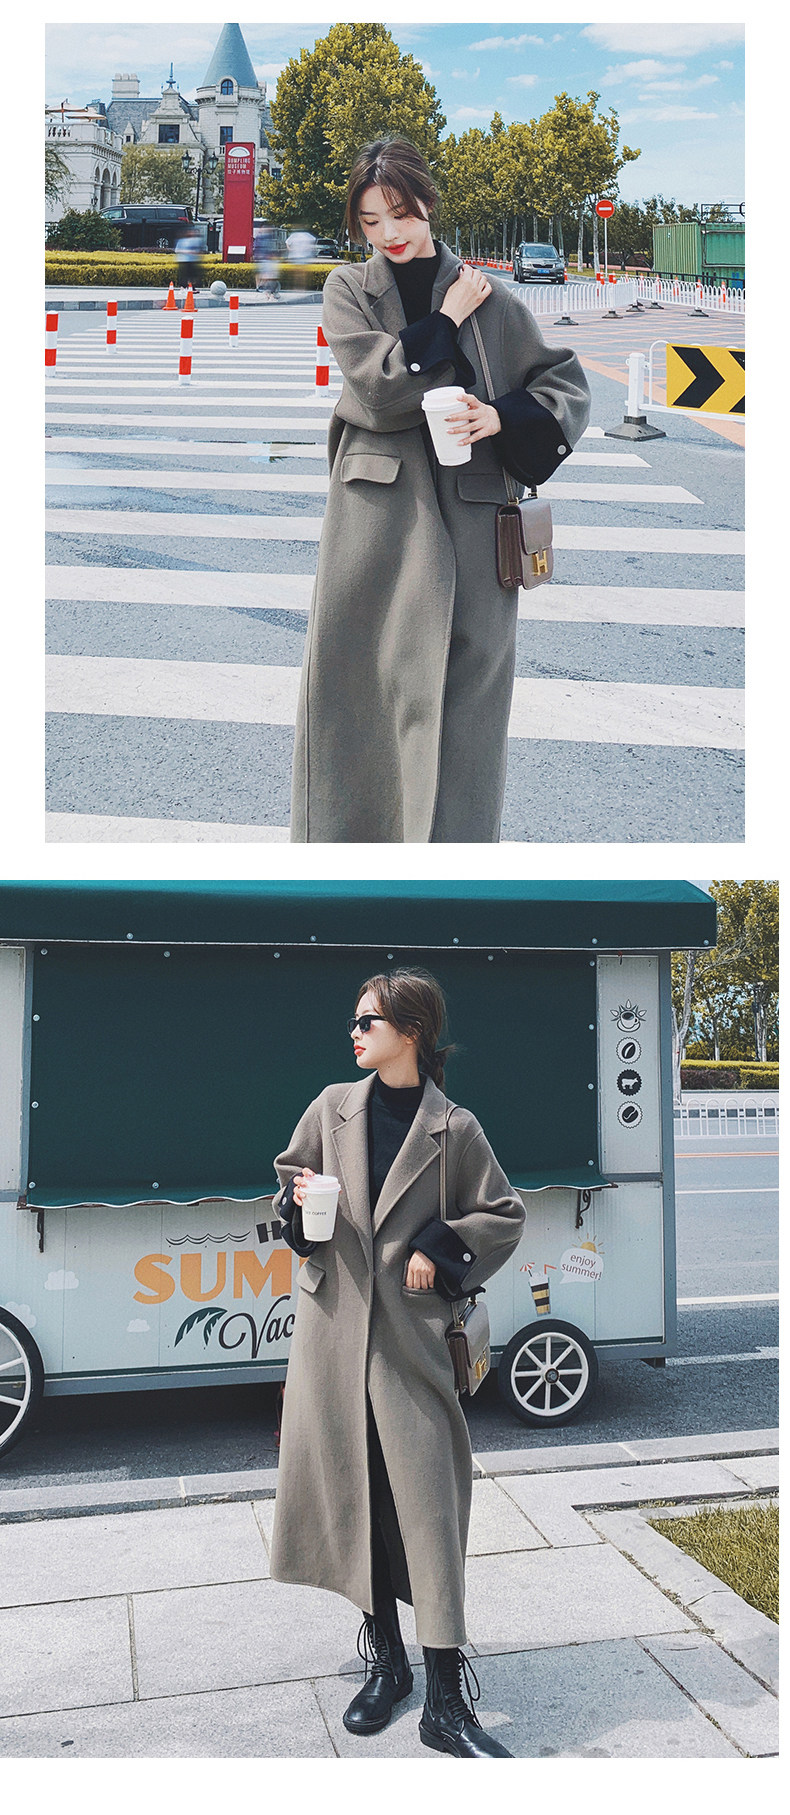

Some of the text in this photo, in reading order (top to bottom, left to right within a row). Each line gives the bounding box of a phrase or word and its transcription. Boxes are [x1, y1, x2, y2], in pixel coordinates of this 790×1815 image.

[570, 1254, 596, 1268] enjoy
[132, 1248, 309, 1305] SUM
[561, 1263, 602, 1280] summer!
